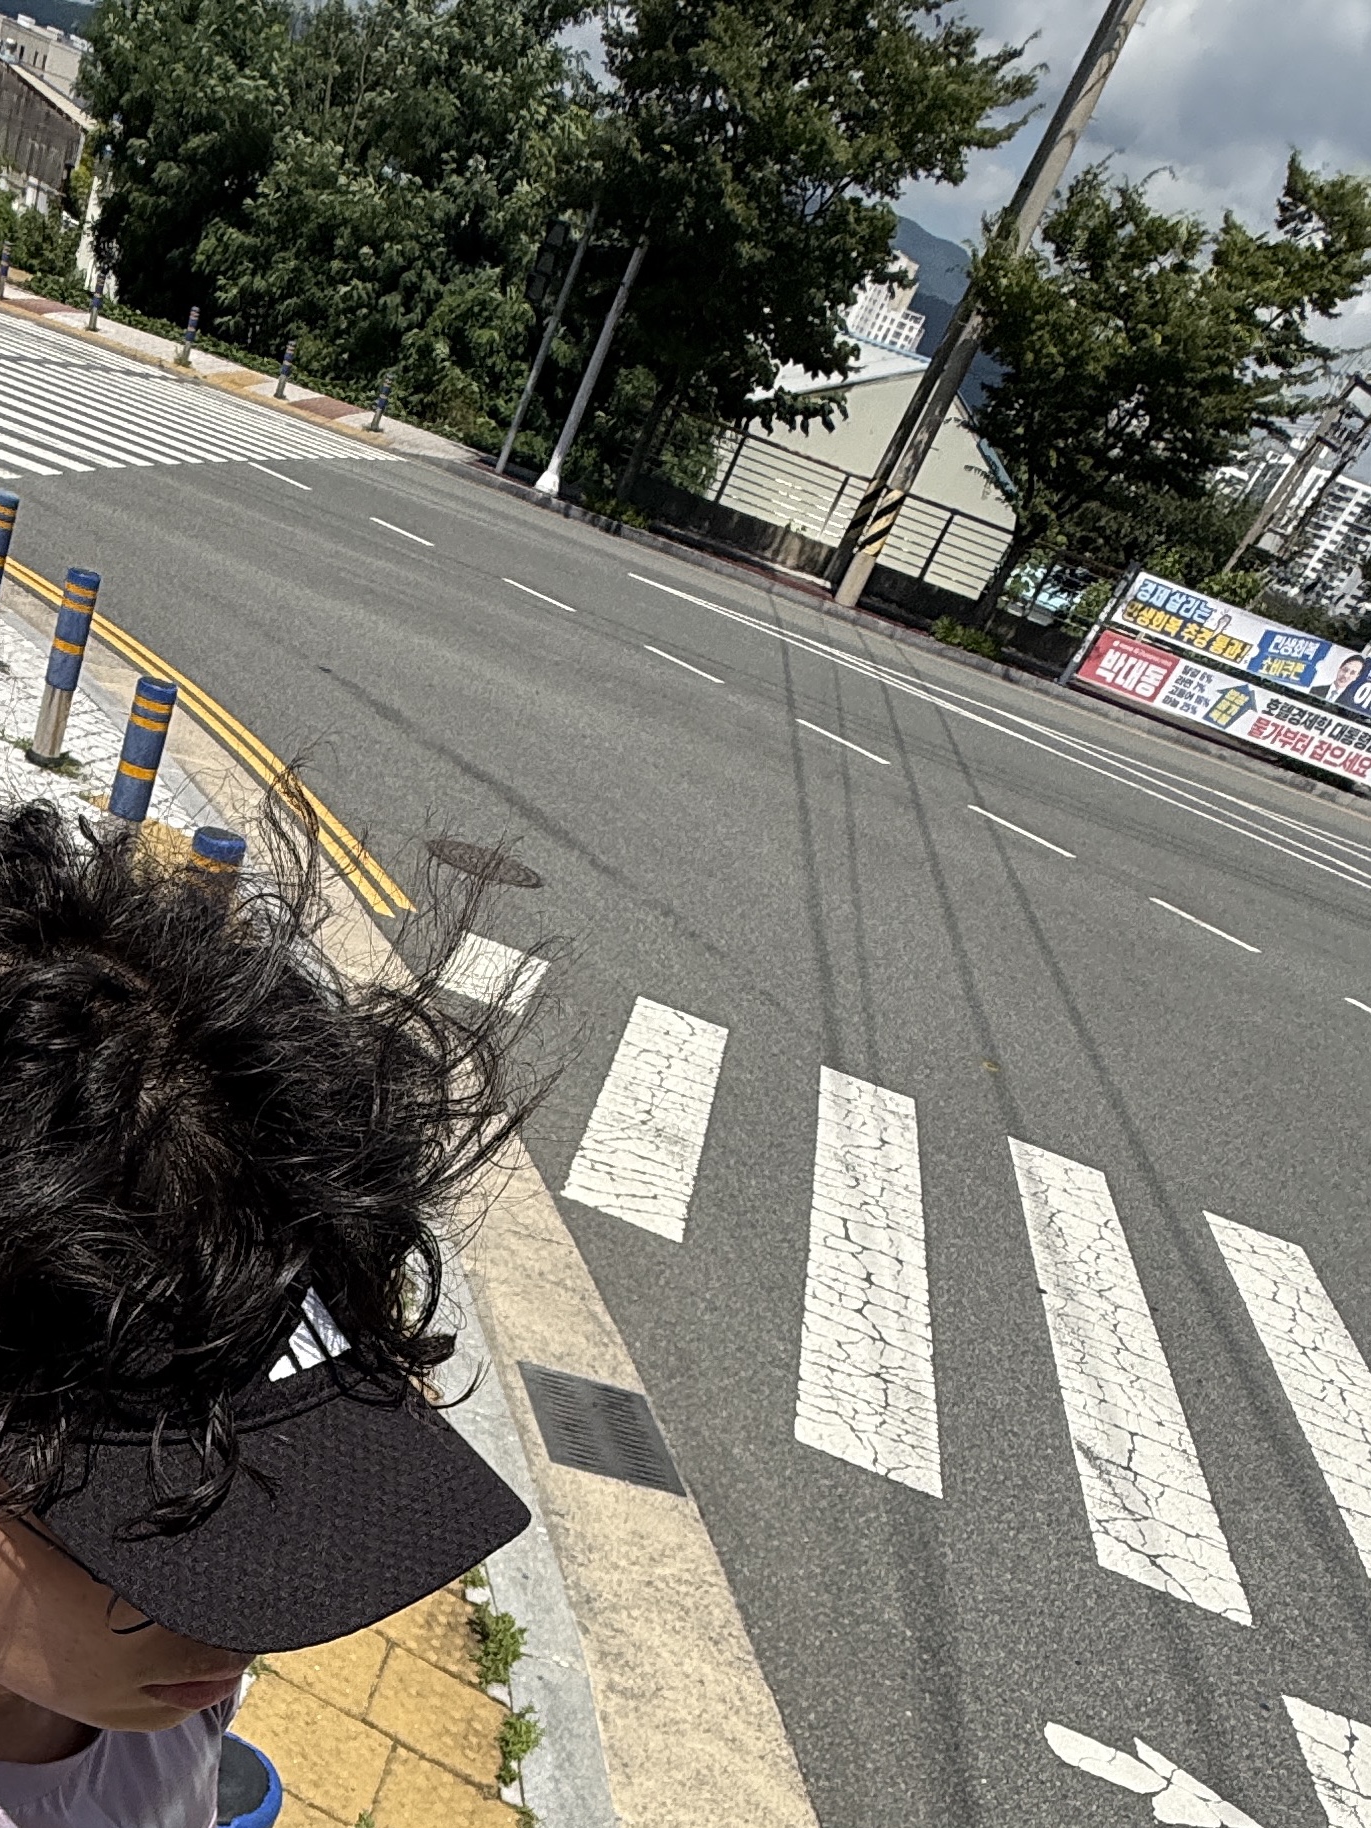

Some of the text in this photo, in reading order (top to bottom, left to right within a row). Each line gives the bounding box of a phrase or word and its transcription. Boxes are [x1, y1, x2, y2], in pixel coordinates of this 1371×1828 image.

[1137, 580, 1212, 622] 경제 살리는
[1181, 621, 1213, 647] 추경
[1269, 633, 1321, 660] 민생회복
[1095, 649, 1168, 699] 박대동
[1247, 716, 1371, 778] 물가부터 잡으세요
[1262, 698, 1371, 753] 호텔경제학 대통령
